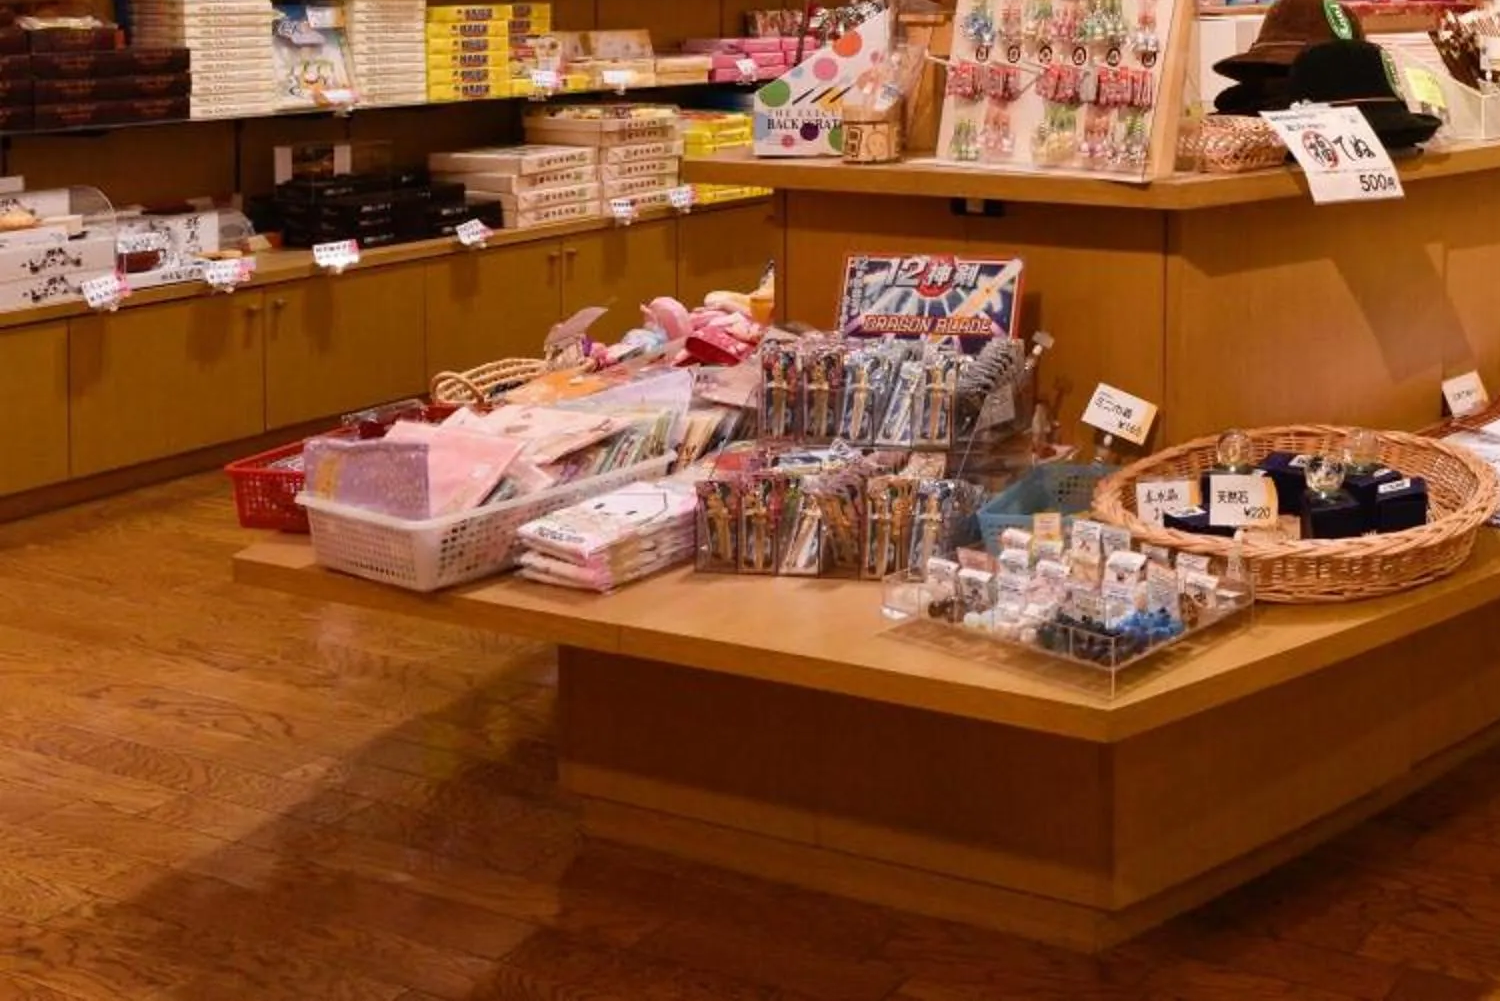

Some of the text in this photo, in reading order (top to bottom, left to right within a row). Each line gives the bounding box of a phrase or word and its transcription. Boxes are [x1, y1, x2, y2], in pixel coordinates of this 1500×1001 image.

[767, 118, 799, 130] BACK
[864, 314, 993, 335] DRAGON BLADE
